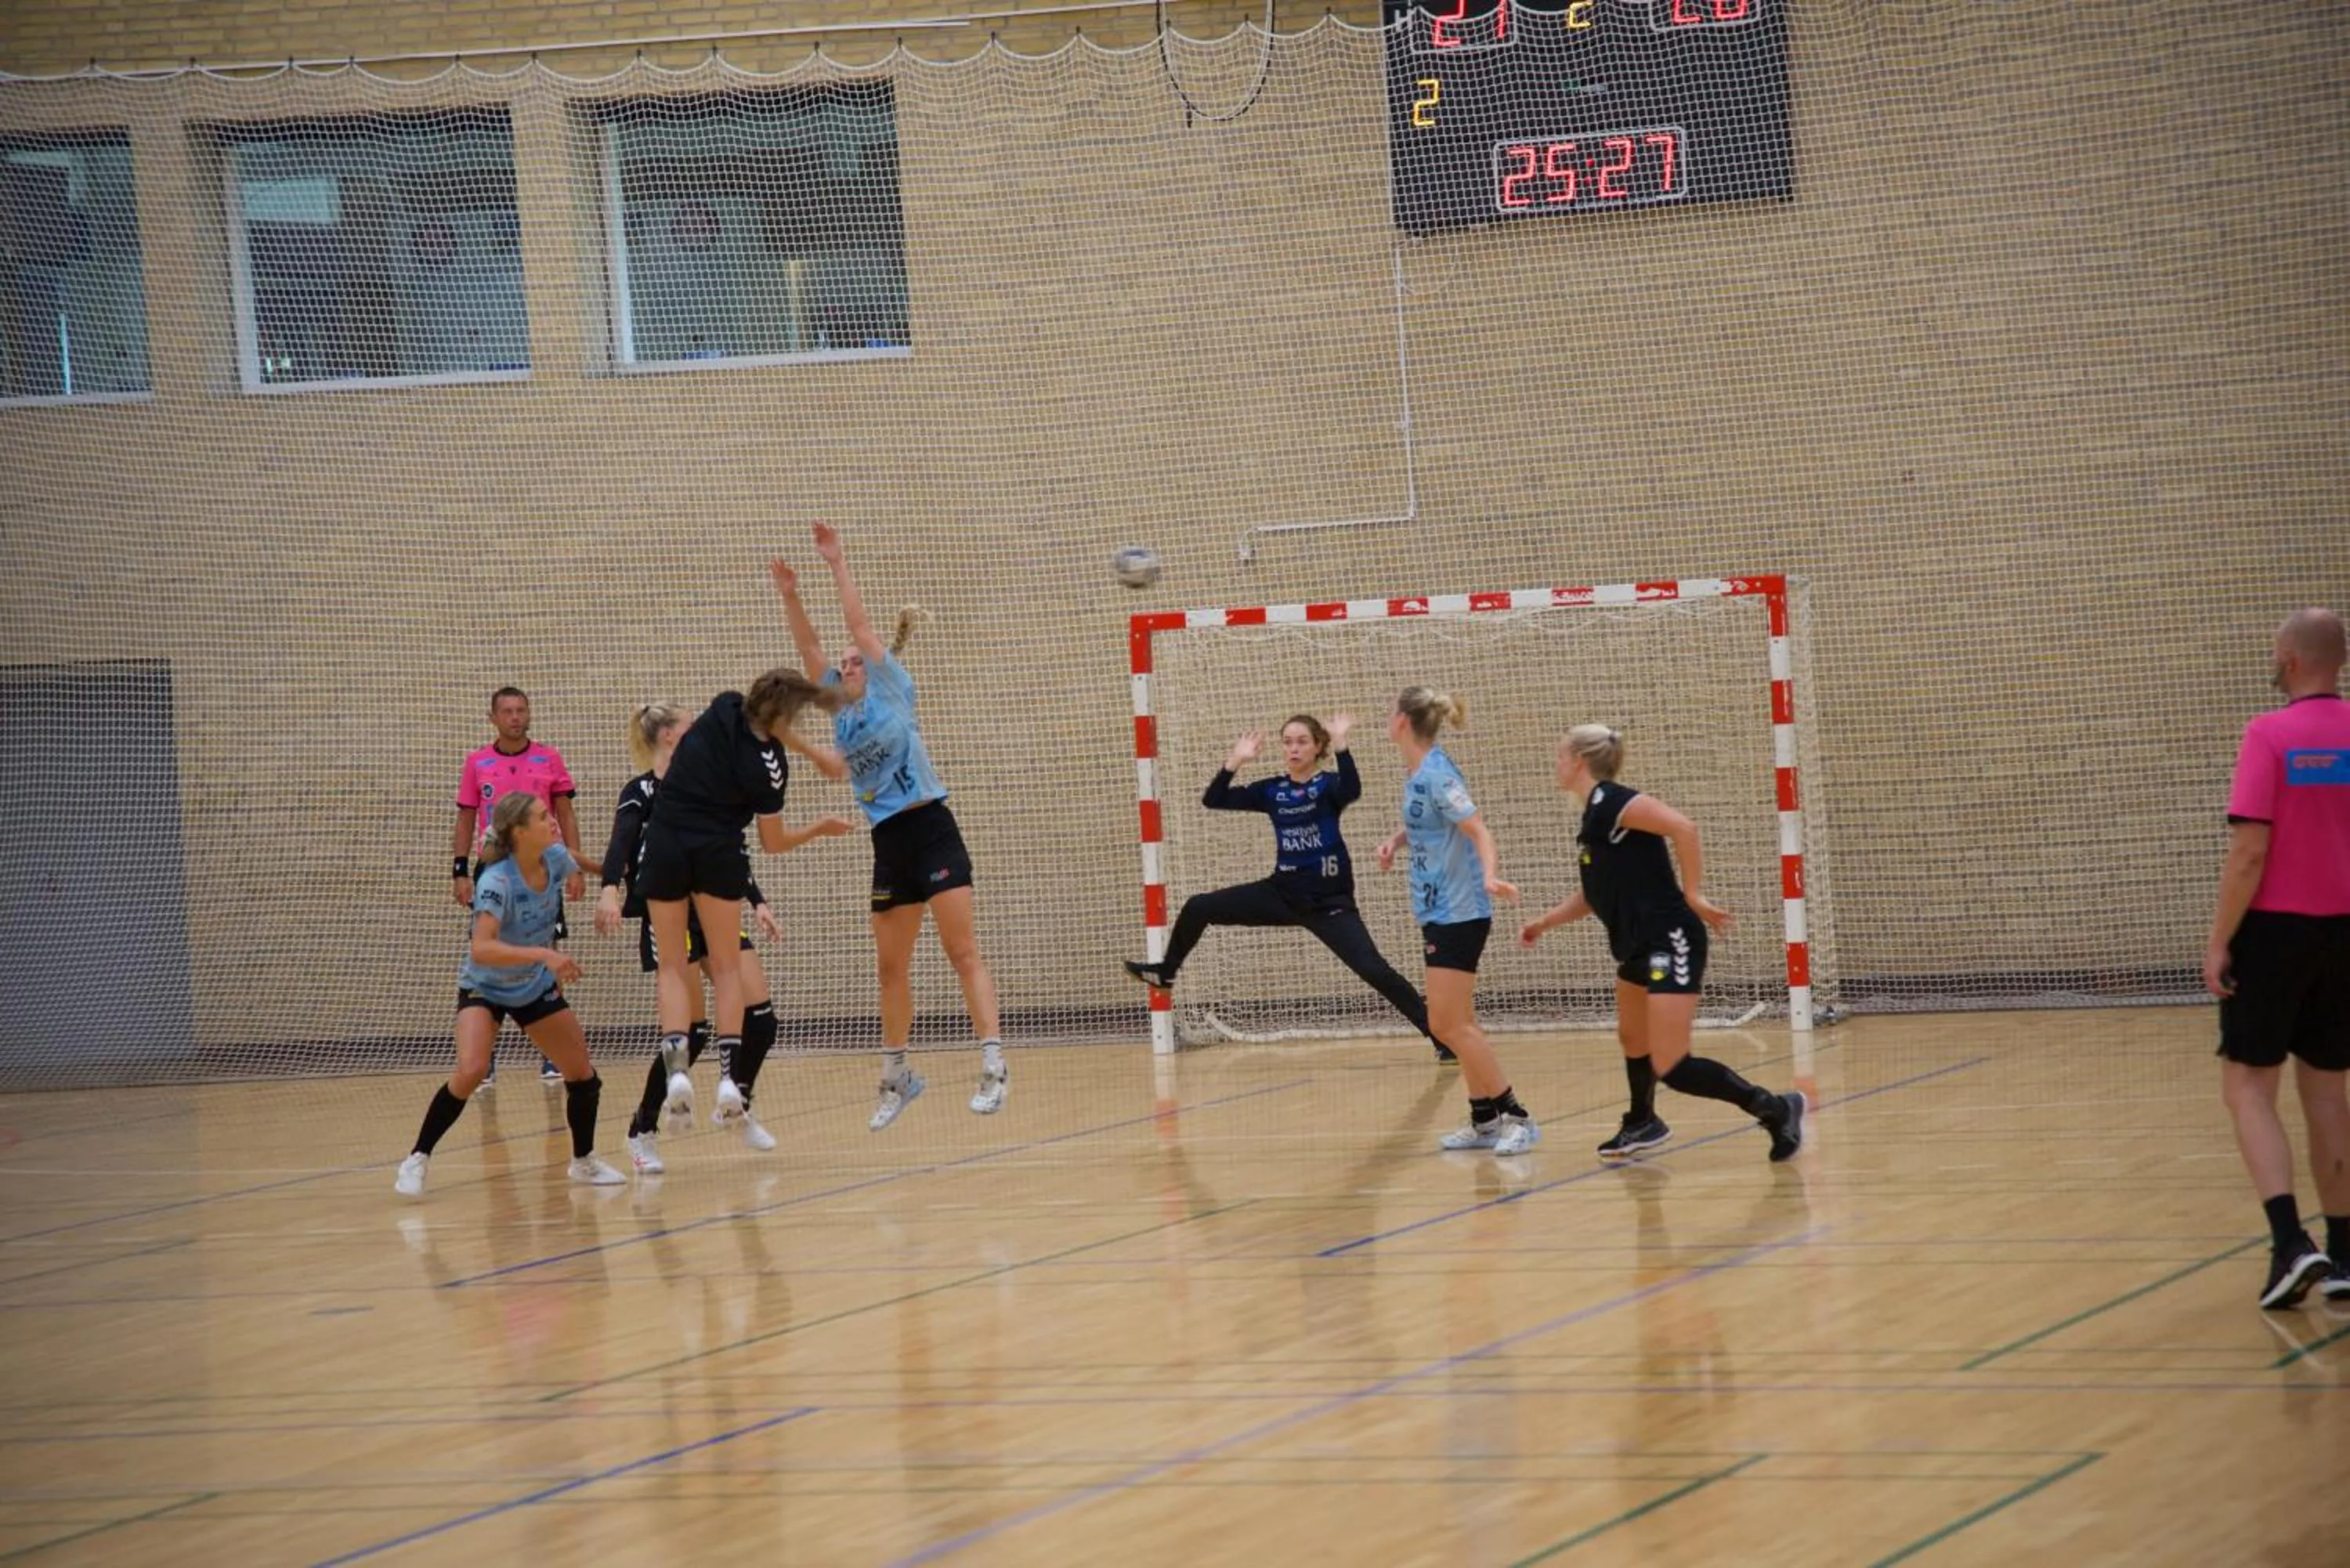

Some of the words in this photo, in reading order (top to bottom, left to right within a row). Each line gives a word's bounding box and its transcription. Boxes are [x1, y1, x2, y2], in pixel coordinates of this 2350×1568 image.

[1414, 80, 1440, 125] 2
[1503, 135, 1674, 207] 25:27
[1282, 833, 1322, 851] BANK
[1321, 854, 1339, 877] 16
